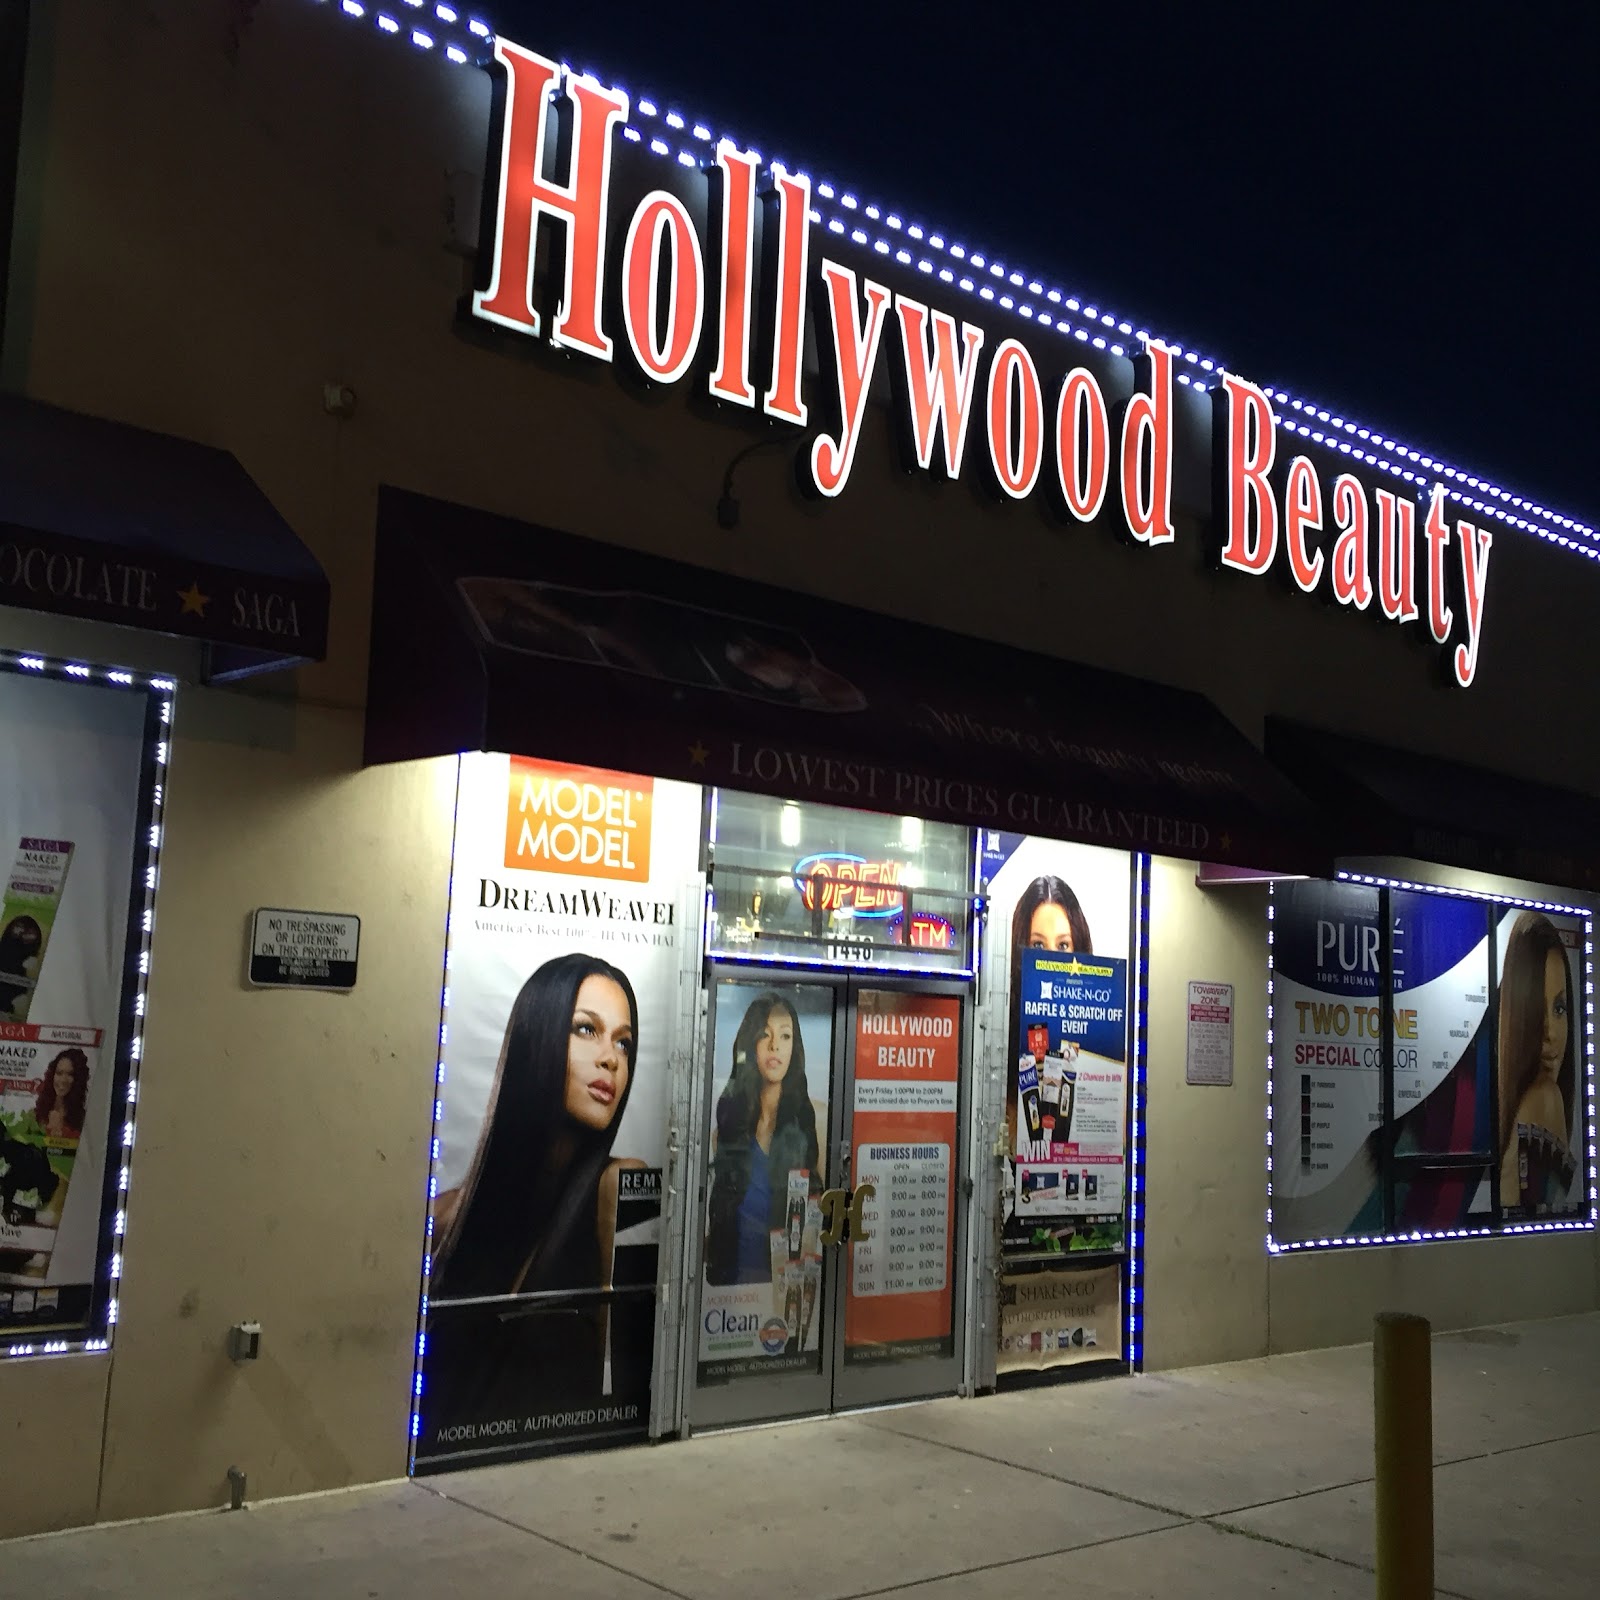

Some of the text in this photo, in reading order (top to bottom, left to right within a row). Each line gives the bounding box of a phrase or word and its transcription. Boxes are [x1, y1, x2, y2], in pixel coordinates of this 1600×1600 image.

[472, 36, 1493, 688] Hollywood Beauty
[232, 585, 301, 638] SAGA
[519, 774, 637, 829] MODEL
[730, 742, 1209, 850] LOWEST PRICES GUARANTEED
[517, 817, 636, 870] MODEL
[24, 852, 58, 865] NAKED
[806, 862, 901, 910] OPEN
[269, 918, 346, 936] NO TRESPASSING
[276, 931, 338, 946] OR LOITERING
[262, 943, 349, 960] ON THIS PROPERTY
[1316, 972, 1339, 984] 100%
[1343, 974, 1375, 987] HUMAN
[1053, 984, 1110, 1003] SHAKE-N-GO
[1201, 996, 1220, 1005] ZONE
[1025, 1001, 1123, 1022] RAFFLE & SCRATCH OFF
[1295, 1001, 1418, 1039] TWO TONE
[862, 1014, 953, 1038] HOLLYWOOD
[1062, 1019, 1088, 1034] EVENT
[877, 1046, 936, 1068] BEAUTY
[1295, 1044, 1361, 1067] SPECIAL
[858, 1087, 874, 1096] Every
[876, 1086, 893, 1096] Friday
[870, 1146, 939, 1160] BUSINESS HOURS
[1022, 1139, 1051, 1162] WIN
[862, 1175, 879, 1184] MON
[892, 1175, 907, 1184] 9:00
[892, 1192, 907, 1201] 9:00
[891, 1209, 906, 1218] 9:00
[890, 1227, 906, 1236] 9:00
[859, 1247, 871, 1255] FRI
[890, 1245, 905, 1254] 9:00
[859, 1264, 873, 1273] SAT
[889, 1263, 904, 1271] 9:00
[858, 1282, 874, 1291] SUN
[885, 1280, 904, 1289] 11:00
[1020, 1281, 1095, 1301] SHAKE-N-GO
[705, 1308, 759, 1335] Clean
[1003, 1304, 1096, 1325] AUTHORIZED DEALER
[437, 1424, 477, 1443] MODEL
[524, 1409, 596, 1432] AUTHORIZED
[597, 1404, 638, 1423] DEALER
